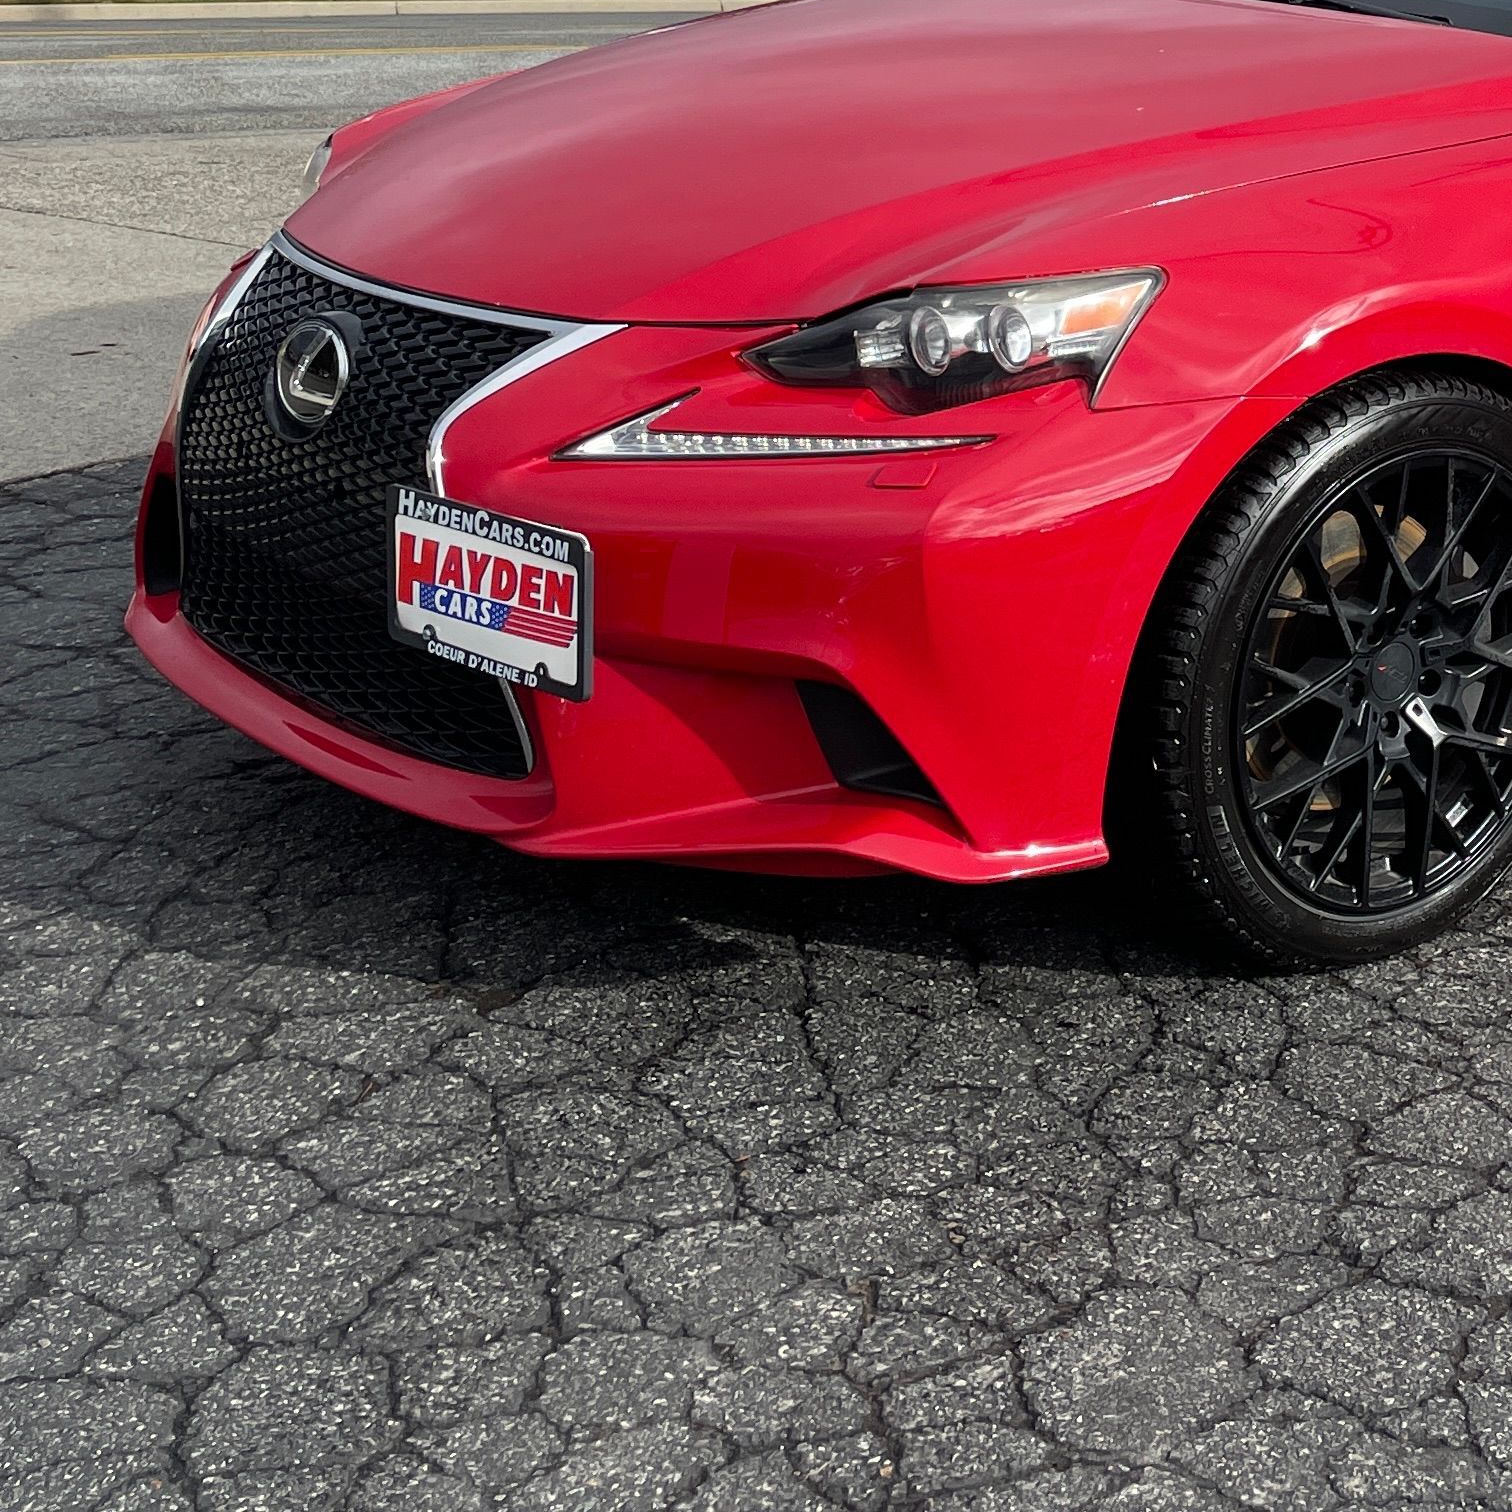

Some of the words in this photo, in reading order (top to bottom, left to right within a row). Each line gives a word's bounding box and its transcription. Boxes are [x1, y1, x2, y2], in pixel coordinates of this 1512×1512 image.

[398, 531, 576, 618] HAYDEN
[434, 587, 492, 626] CARS
[427, 640, 466, 666] COEUR
[524, 672, 539, 688] ID
